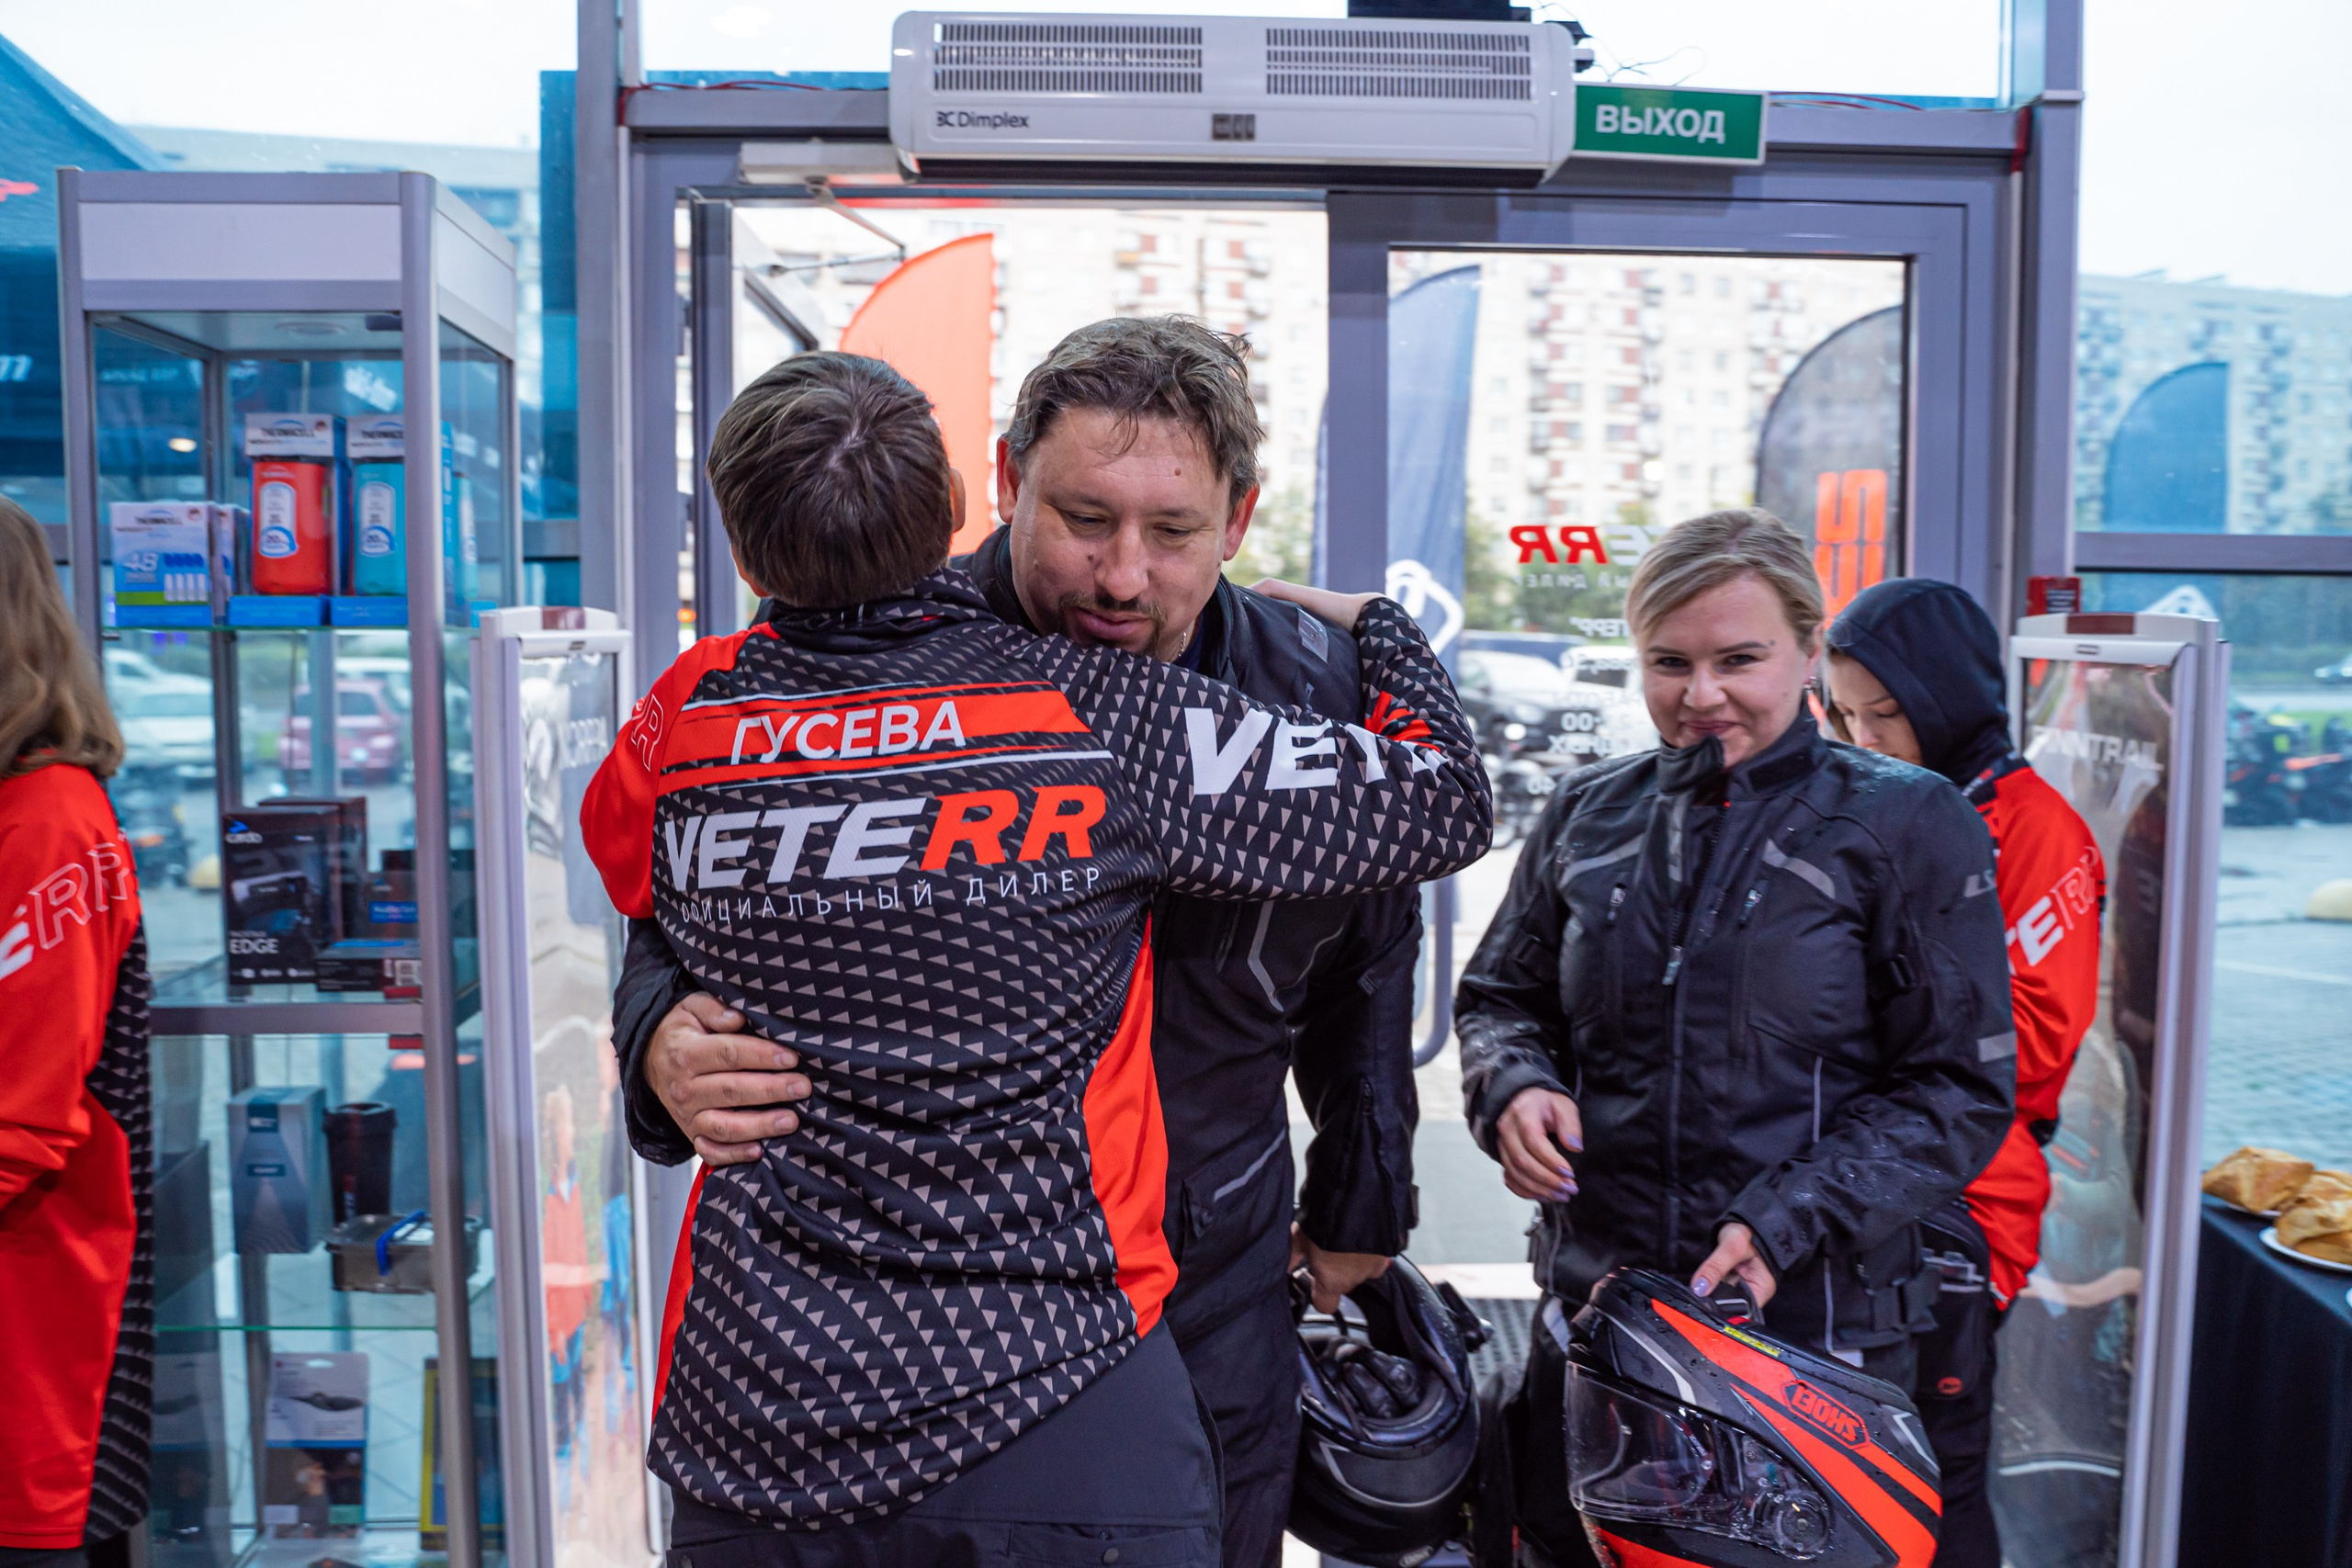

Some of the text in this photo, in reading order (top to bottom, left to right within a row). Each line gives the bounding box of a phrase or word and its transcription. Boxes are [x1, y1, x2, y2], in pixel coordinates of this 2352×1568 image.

[958, 111, 1029, 130] Dimplex
[1595, 104, 1725, 144] ВЫХОД
[730, 700, 967, 765] ГУСЕВА
[664, 784, 1106, 892] VETERR
[681, 866, 1101, 924] ОФИЦИАЛЬНЫЙ ДИЛЕР
[230, 938, 278, 954] EDGE
[1792, 1383, 1860, 1442] SHOEI
